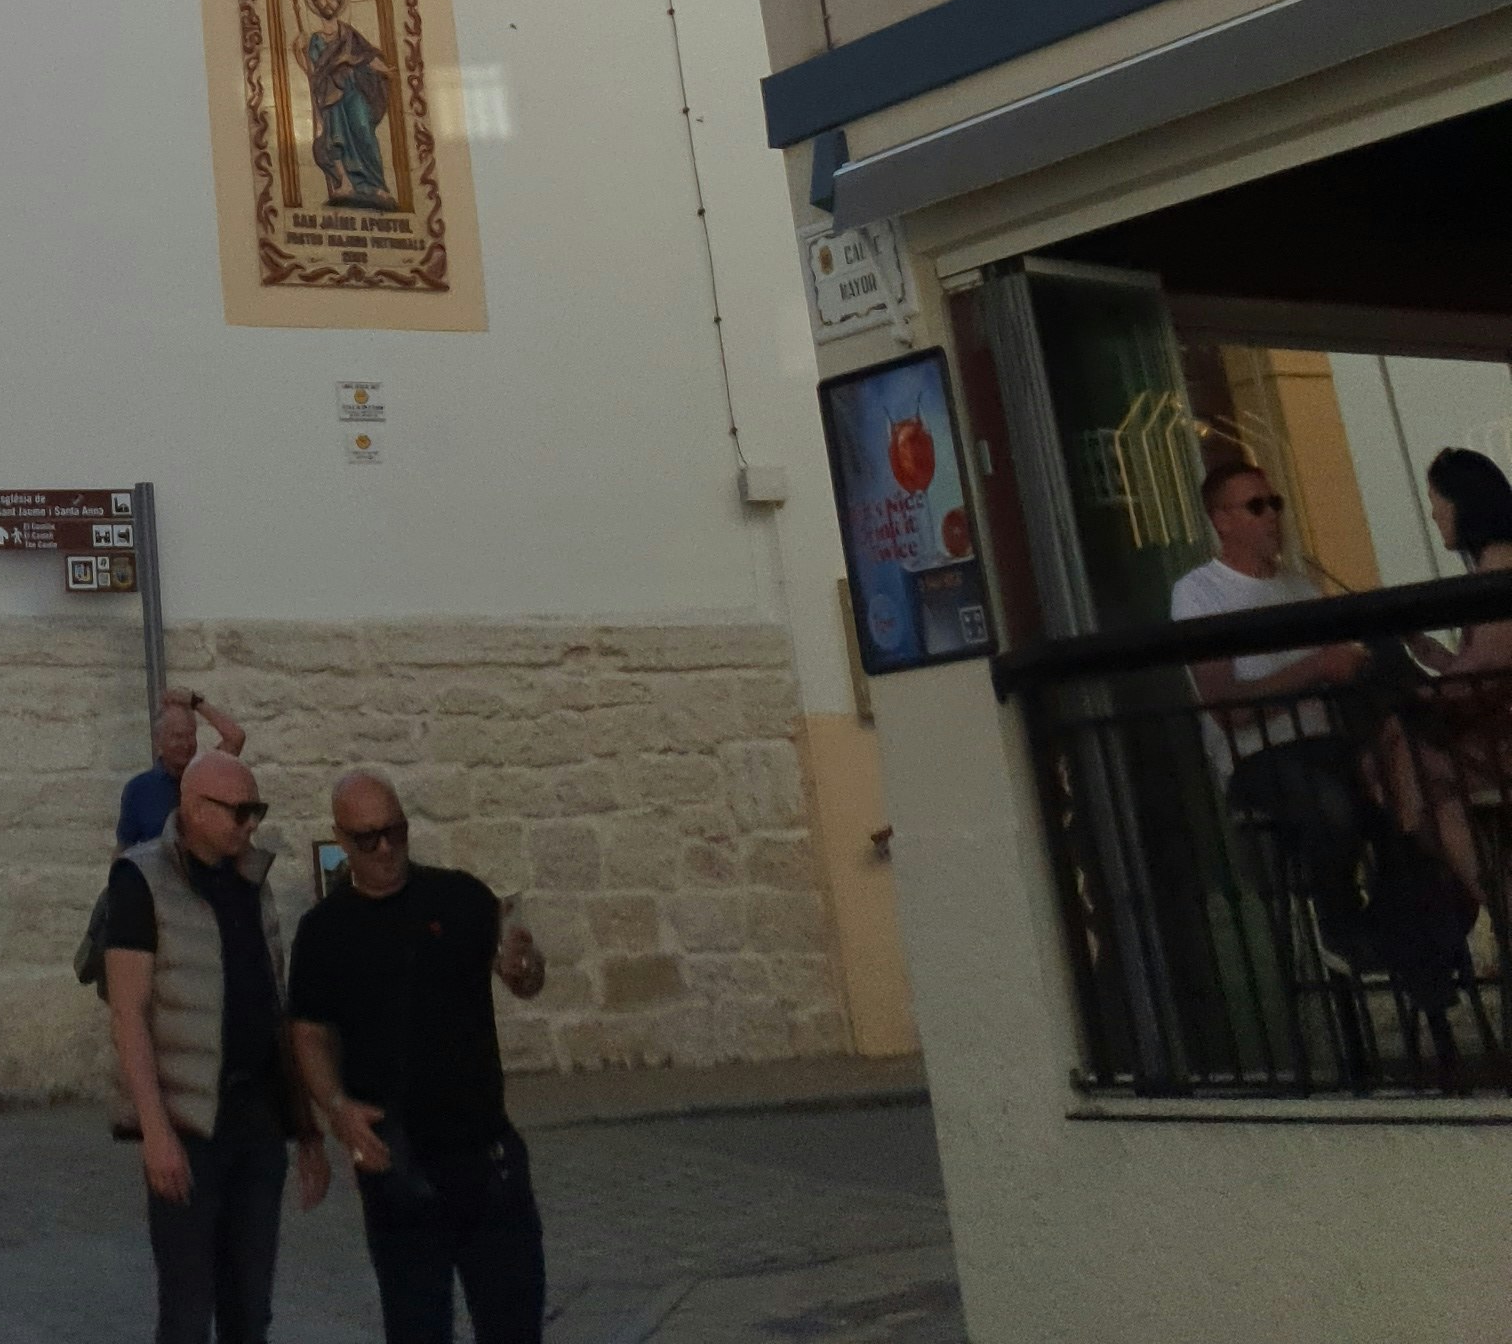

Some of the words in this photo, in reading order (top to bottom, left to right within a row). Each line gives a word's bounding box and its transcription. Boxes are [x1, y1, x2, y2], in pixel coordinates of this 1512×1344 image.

[844, 235, 882, 265] CALE
[840, 272, 877, 300] MAYOR
[54, 506, 80, 516] Santa
